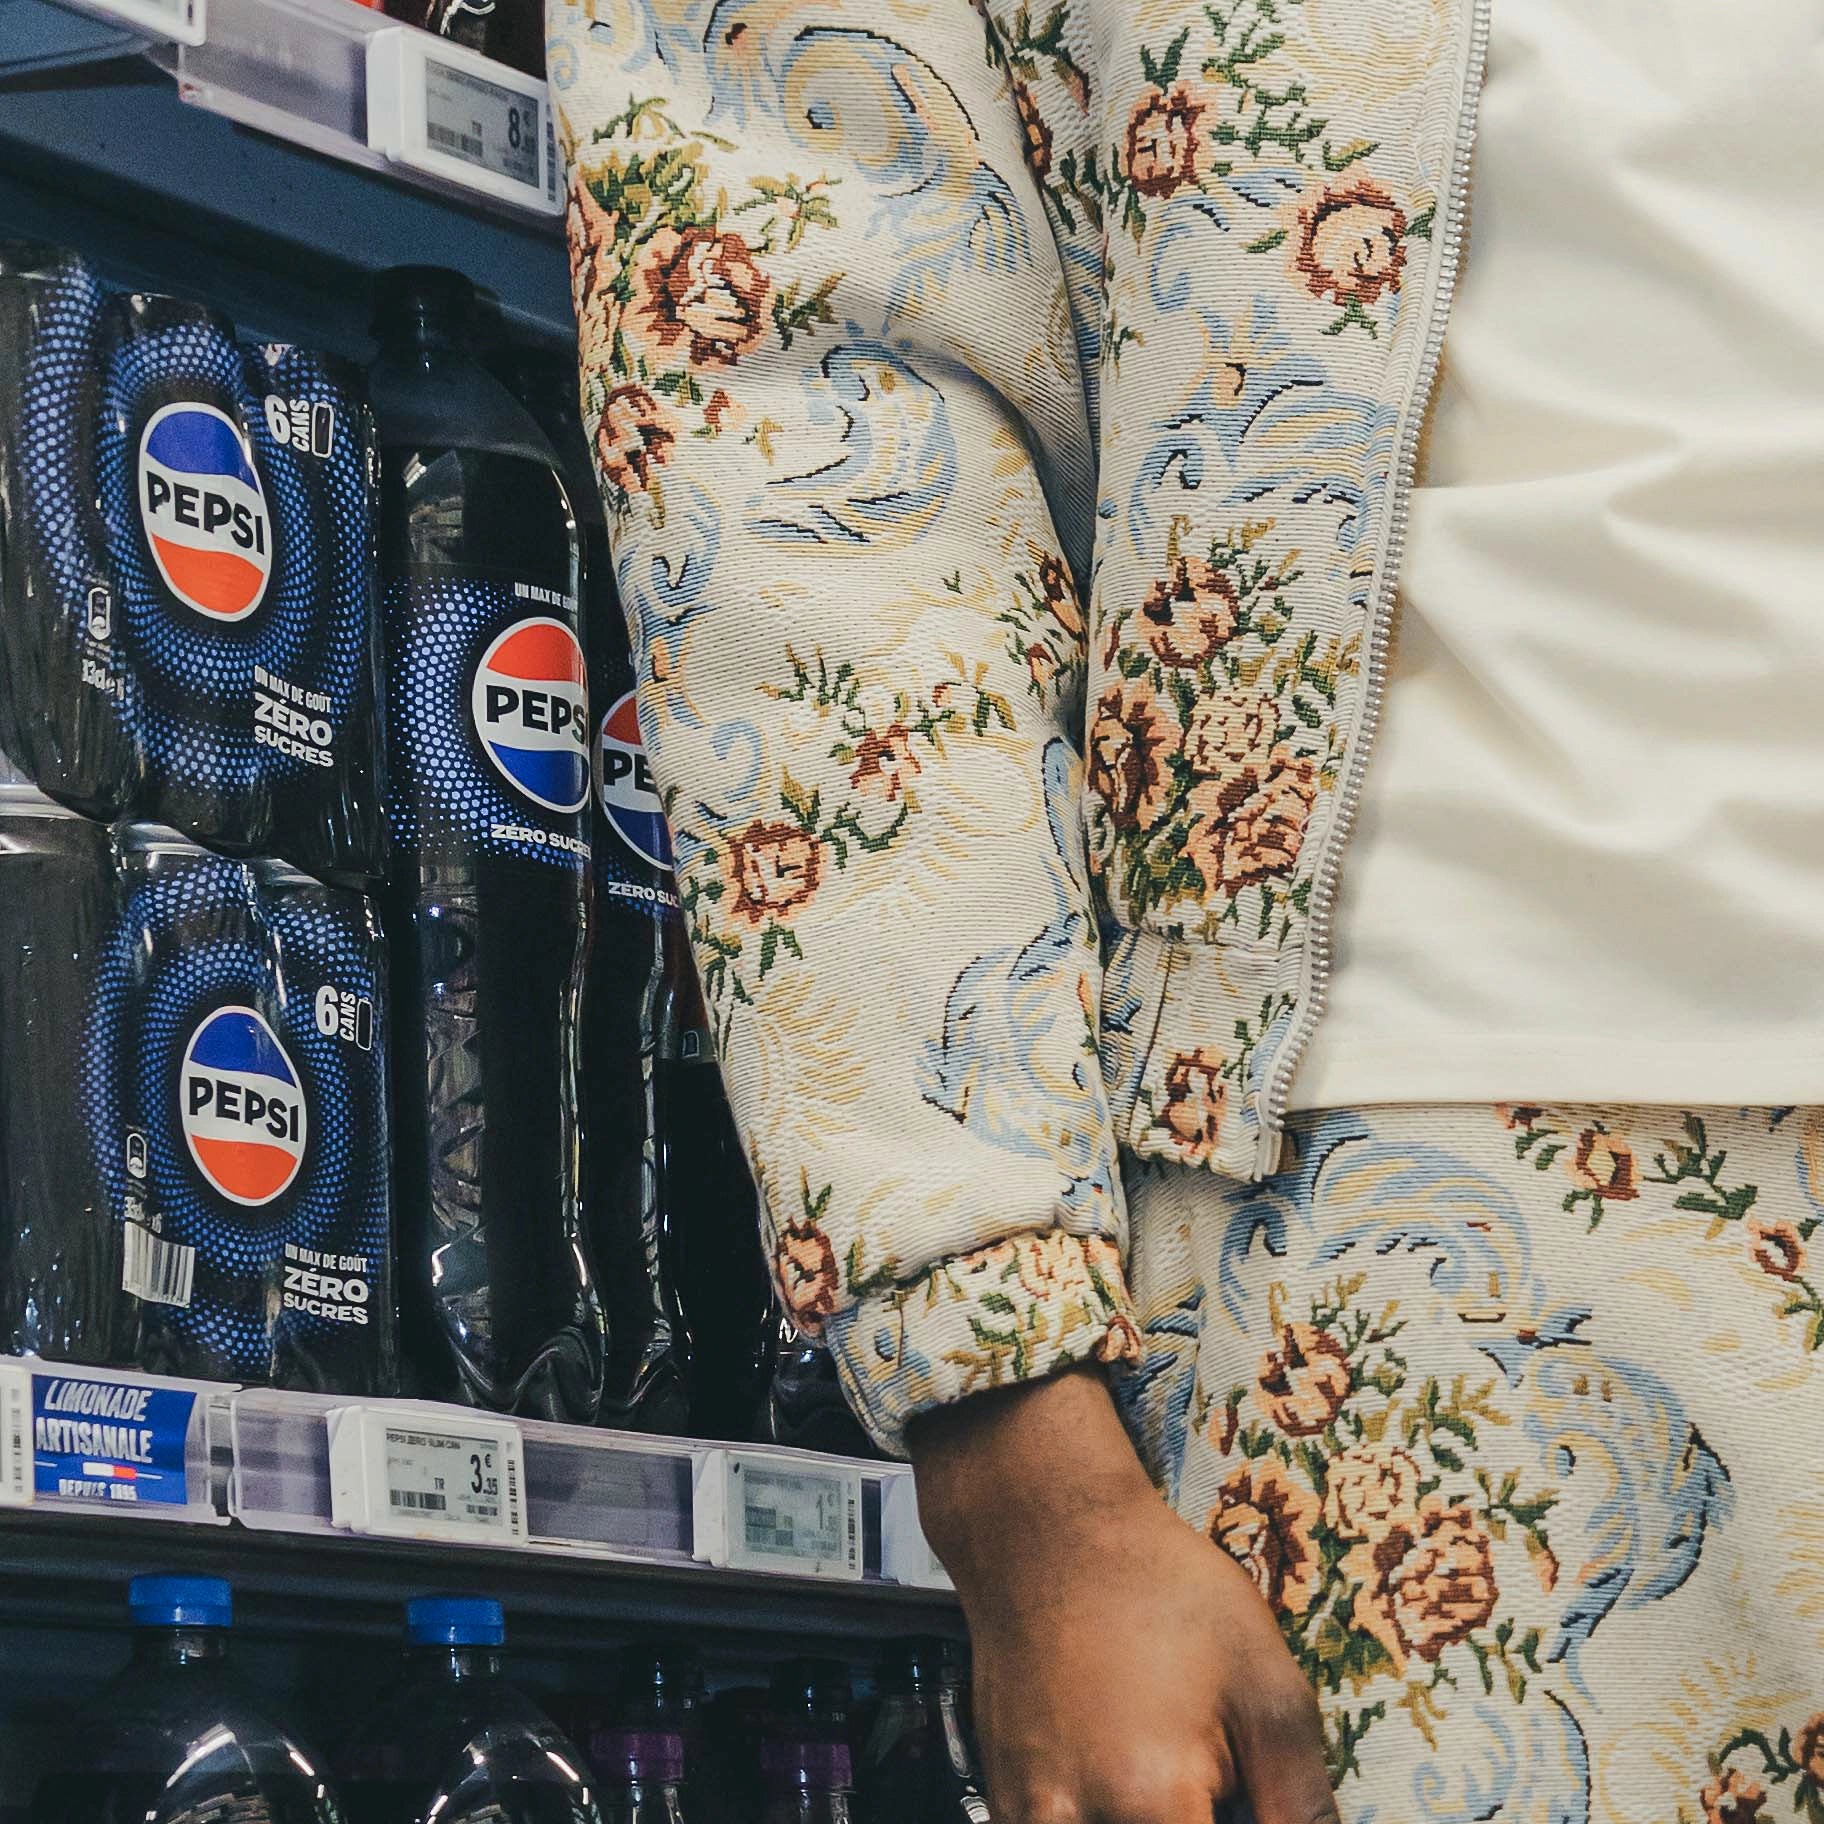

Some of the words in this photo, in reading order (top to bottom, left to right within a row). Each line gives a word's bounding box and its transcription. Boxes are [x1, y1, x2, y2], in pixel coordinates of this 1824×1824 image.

[265, 394, 291, 444] 6
[290, 399, 310, 451] CANS
[146, 471, 265, 555] PEPSI
[254, 692, 332, 746] ZÉRO
[305, 688, 331, 713] GOÛT
[486, 685, 587, 746] PEPS
[254, 725, 333, 767] SUCRES
[490, 822, 547, 844] ZÉRO
[608, 881, 655, 901] ZÉRO
[315, 986, 339, 1035] 6
[340, 991, 356, 1042] CANS
[189, 1077, 299, 1142] PEPSI
[284, 1266, 369, 1303] ZÉRO
[322, 1252, 337, 1269] DE
[339, 1253, 368, 1273] GOÛT
[284, 1291, 369, 1324] SUCRES
[45, 1380, 153, 1422] LIMONADE
[36, 1417, 153, 1463] ARTISANALE
[470, 1454, 482, 1494] 3
